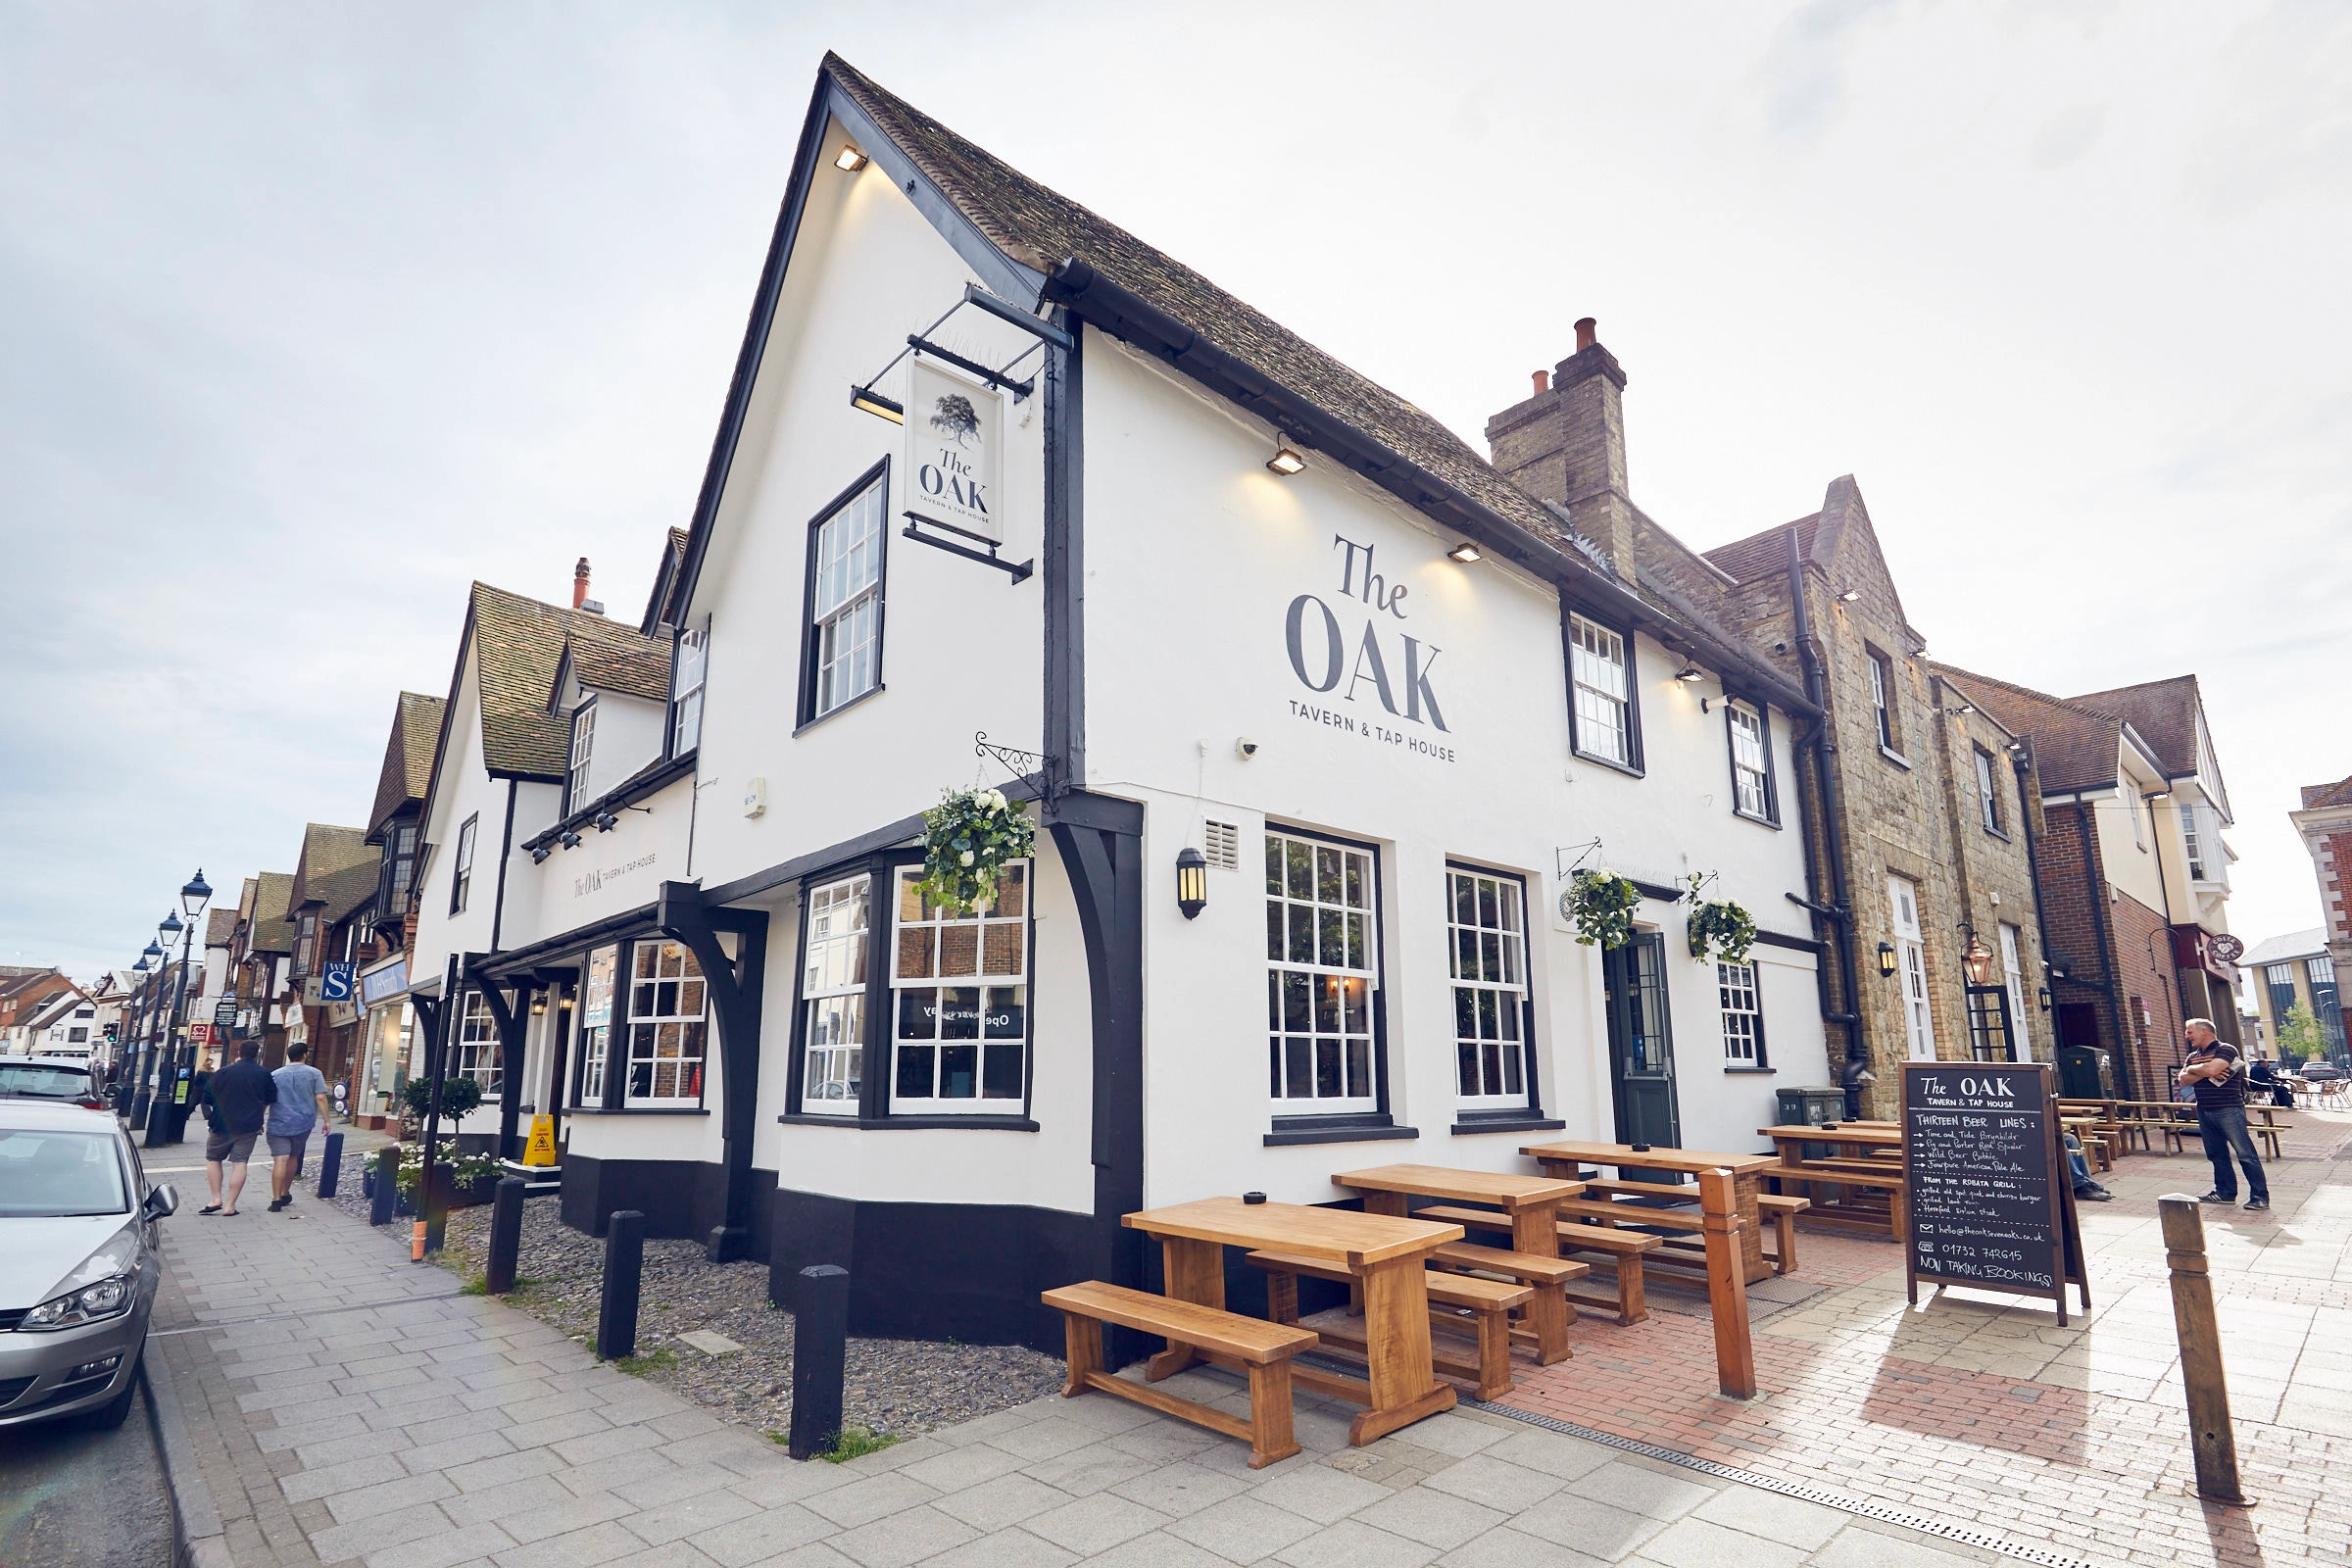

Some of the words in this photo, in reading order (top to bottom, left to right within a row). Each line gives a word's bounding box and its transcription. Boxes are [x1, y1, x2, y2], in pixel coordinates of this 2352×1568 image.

[941, 448, 971, 476] The
[919, 464, 988, 514] OAK
[919, 495, 946, 509] TAVERN
[954, 507, 966, 516] TAP
[968, 512, 989, 524] HOUSE
[1334, 533, 1408, 619] The
[1286, 594, 1451, 733] OAK
[1289, 700, 1354, 732] TAVERN
[1361, 722, 1370, 737] &
[1376, 726, 1402, 746] TAP
[1409, 737, 1455, 762] HOUSE
[585, 869, 603, 895] OAK
[603, 866, 621, 881] TAVERN
[637, 853, 656, 868] HOUSE
[2212, 936, 2235, 945] COSTA
[2212, 950, 2240, 959] COFFEE
[329, 962, 350, 972] WH
[325, 970, 348, 998] S
[1921, 1076, 1946, 1095] The
[1960, 1077, 2015, 1097] OAK
[1927, 1098, 1956, 1106] TAVERN
[1968, 1099, 1984, 1107] TAP
[1916, 1113, 1958, 1127] THIRTEEN
[1962, 1116, 1988, 1129] BEER
[1925, 1129, 1942, 1138] Time
[1926, 1139, 1936, 1152] Pig
[1954, 1139, 1975, 1149] Porter
[1979, 1142, 1993, 1151] Red
[1997, 1141, 2026, 1155] Spider
[1927, 1149, 1944, 1158] Wild
[1948, 1150, 1968, 1160] Beer
[1962, 1160, 1992, 1170] American
[1992, 1160, 2009, 1172] Pale
[2010, 1162, 2026, 1172] Ale
[1962, 1178, 1989, 1188] ROBATA
[1920, 1186, 1940, 1198] grilled
[2020, 1194, 2041, 1203] burger
[1921, 1196, 1942, 1205] grilled
[1942, 1244, 1976, 1257] 01732
[1982, 1248, 2023, 1261] 742615
[1921, 1255, 1940, 1272] NOW
[1946, 1260, 1984, 1278] TAKING
[1984, 1264, 2054, 1288] BOOKINGS!
